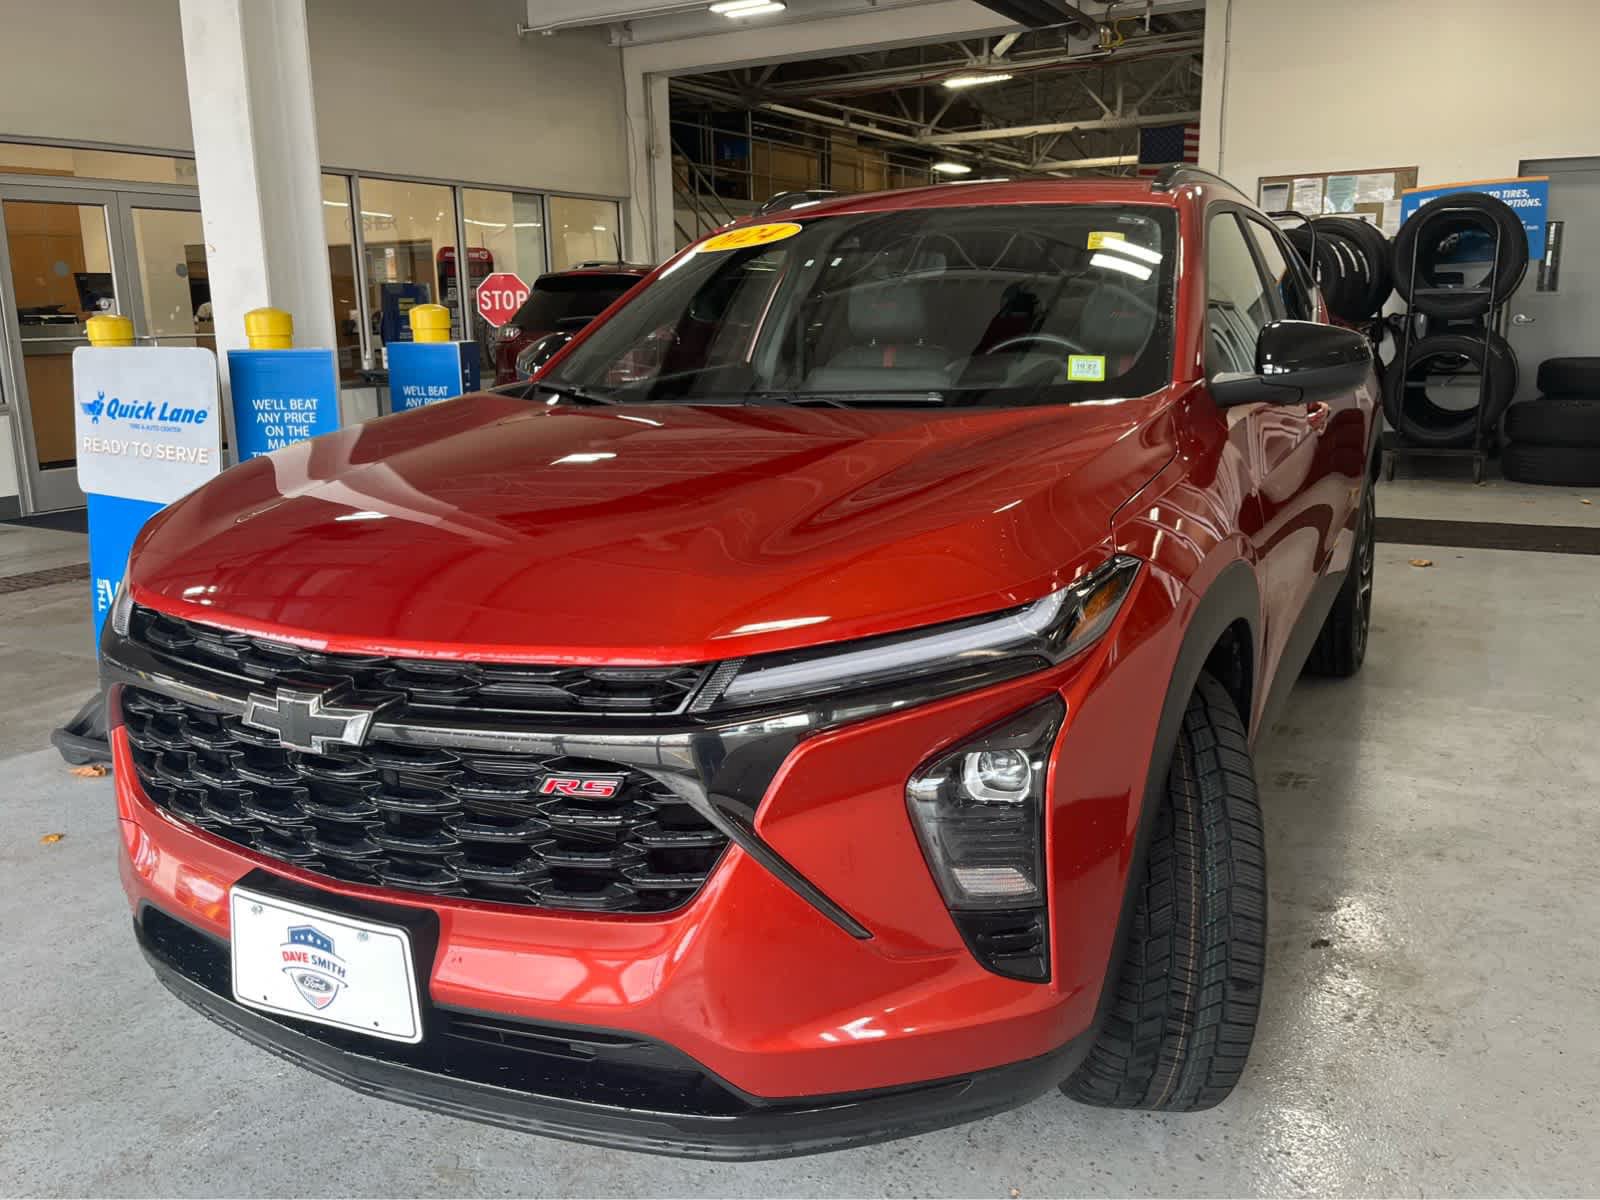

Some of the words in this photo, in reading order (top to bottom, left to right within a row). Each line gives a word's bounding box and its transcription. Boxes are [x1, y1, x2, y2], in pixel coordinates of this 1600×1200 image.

[480, 290, 528, 311] STOP
[402, 385, 427, 397] WE'LL
[428, 385, 449, 397] BEAT
[106, 398, 156, 421] Quick
[158, 401, 208, 424] Lane
[252, 399, 287, 411] WE'LL
[289, 399, 319, 411] BEAT
[406, 397, 422, 408] ANY
[256, 412, 280, 424] ANY
[284, 412, 317, 424] PRICE
[265, 425, 284, 437] ON
[286, 425, 310, 437] THE
[83, 436, 129, 456] READY
[131, 441, 153, 458] TO
[156, 444, 209, 466] SERVE
[97, 577, 106, 612] THE
[539, 778, 618, 797] RS
[282, 951, 309, 963] DAVE
[311, 955, 346, 978] SMITH
[303, 975, 327, 991] Ford
